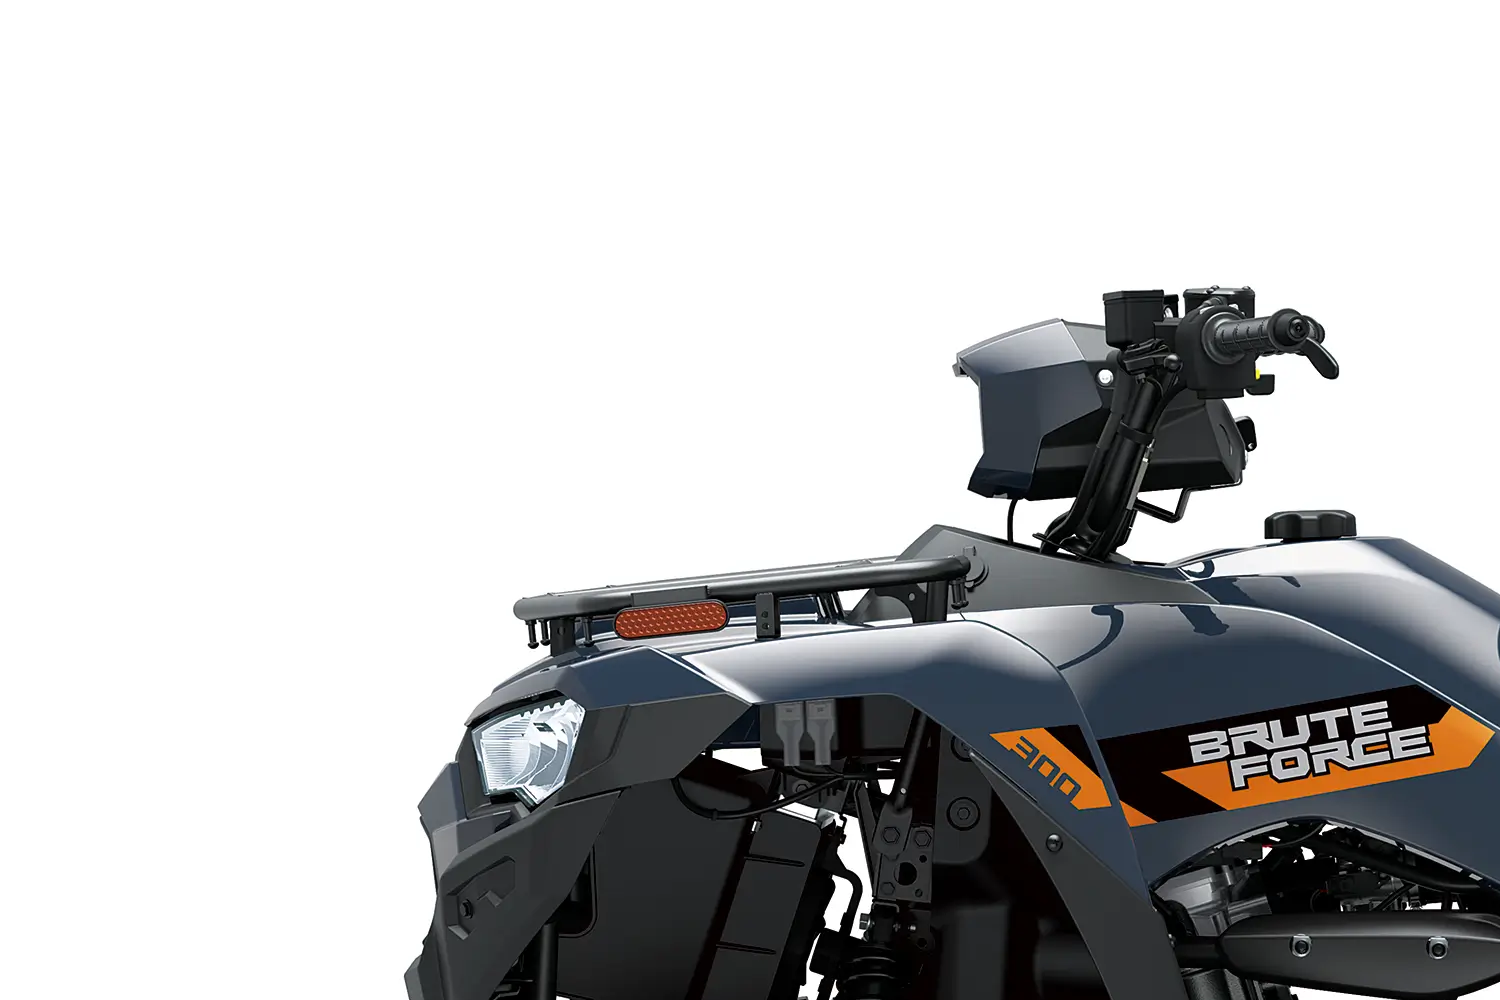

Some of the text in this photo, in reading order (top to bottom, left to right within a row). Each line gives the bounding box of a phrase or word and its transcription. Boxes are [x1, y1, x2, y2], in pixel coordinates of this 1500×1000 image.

[1188, 700, 1389, 764] BRUTE
[1230, 726, 1431, 789] FORCE
[1008, 735, 1082, 802] 300
